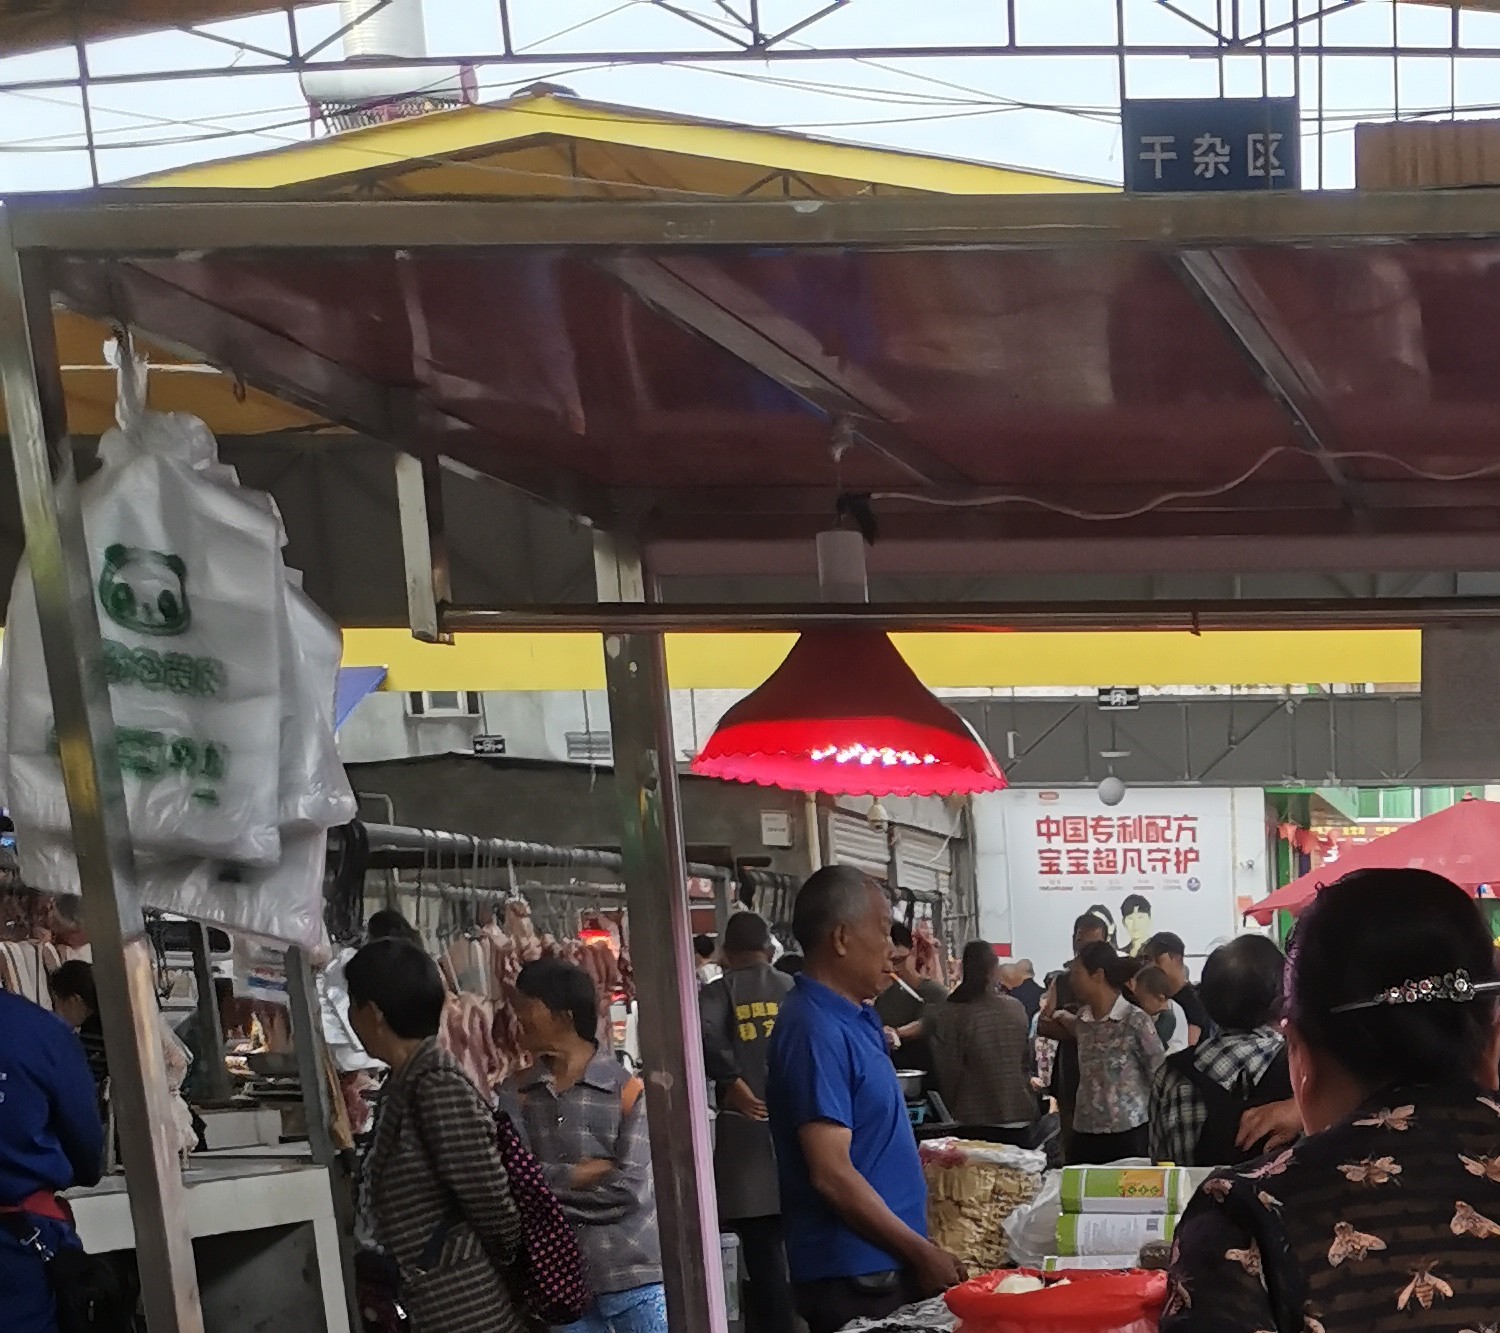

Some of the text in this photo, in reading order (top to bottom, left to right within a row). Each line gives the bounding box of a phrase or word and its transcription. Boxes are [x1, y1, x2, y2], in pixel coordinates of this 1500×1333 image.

[1139, 132, 1286, 179] 干杂区
[1036, 814, 1198, 844] 中国专利配方
[1037, 846, 1201, 875] 宝宝超凡守护
